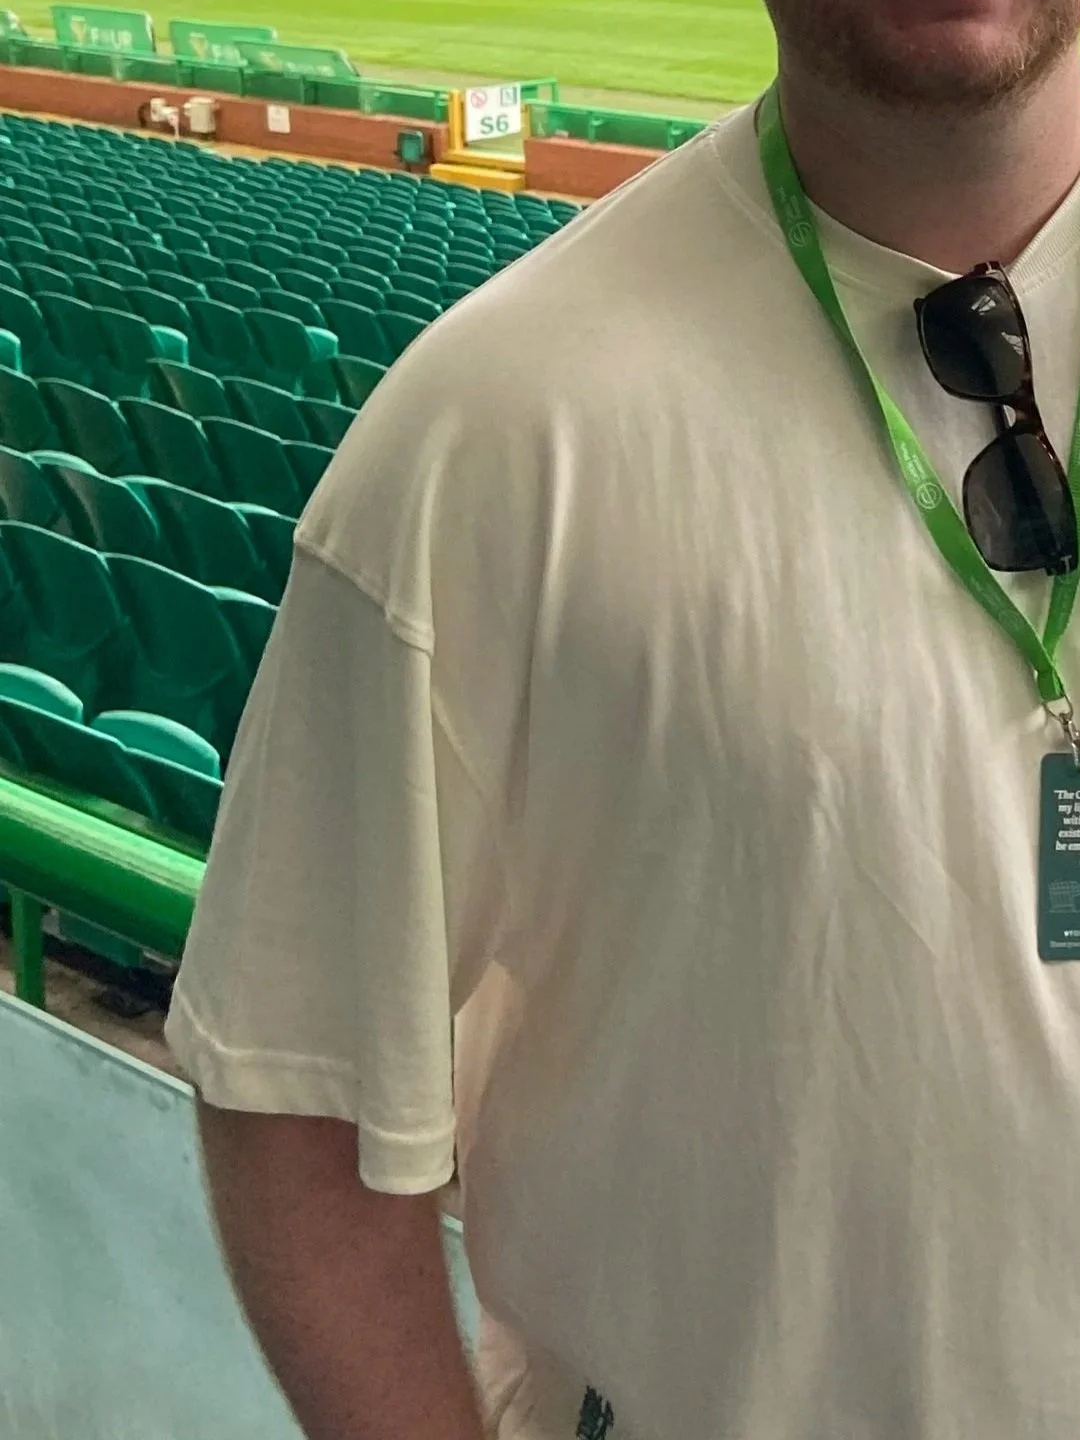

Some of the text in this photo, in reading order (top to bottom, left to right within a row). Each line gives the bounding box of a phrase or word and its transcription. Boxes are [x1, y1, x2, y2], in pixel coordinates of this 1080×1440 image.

[480, 114, 509, 135] S6
[1058, 804, 1073, 815] my
[1055, 840, 1067, 851] be
